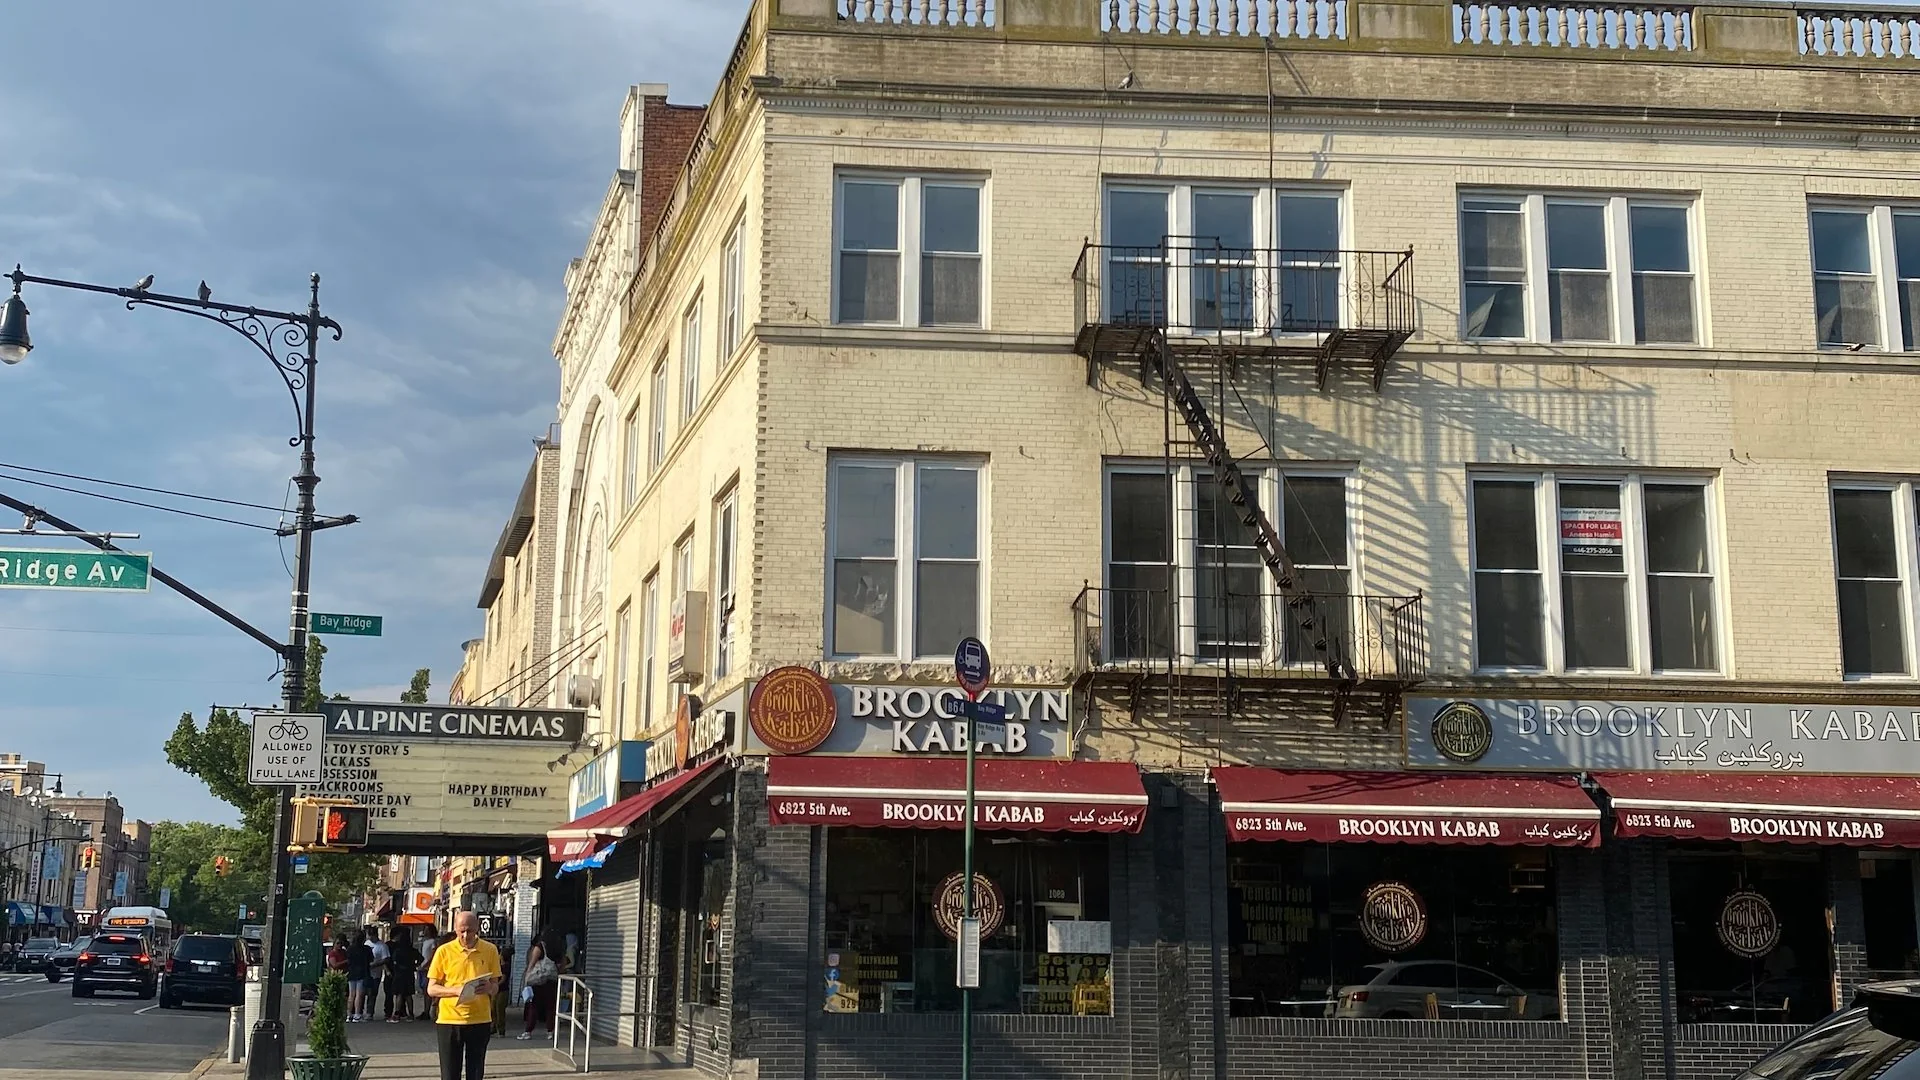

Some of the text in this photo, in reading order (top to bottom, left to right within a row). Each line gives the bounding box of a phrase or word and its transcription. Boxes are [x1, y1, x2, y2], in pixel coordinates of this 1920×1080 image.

[1600, 523, 1618, 531] LEASE
[87, 561, 125, 582] Av
[320, 615, 372, 630] Bay Ridge
[948, 701, 965, 714] B64
[334, 709, 565, 737] ALPINE CINEMAS
[1517, 704, 1753, 739] BROOKLYN
[262, 743, 312, 751] ALLOWED
[333, 744, 357, 754] TOY
[360, 744, 399, 756] STORY
[402, 745, 410, 755] 5
[267, 756, 306, 765] USE OF
[323, 756, 371, 767] ACKASS
[1654, 741, 1804, 770] بروكلين كباب
[256, 769, 316, 778] FULL LANE
[310, 782, 384, 793] BACKROOMS
[448, 784, 547, 797] HAPPY BIRTHDAY
[387, 795, 412, 806] DAY
[473, 797, 512, 808] DAVEY
[779, 802, 806, 817] 6823
[808, 802, 826, 817] 5th
[828, 803, 851, 817] Ave.
[985, 805, 1045, 824] KABAB
[1235, 817, 1500, 838] 6823 5th Ave. BROOKLYN KABAB
[1626, 813, 1884, 839] 6823 5th Ave. BROOKLYN KABAB
[1286, 884, 1312, 903] Food
